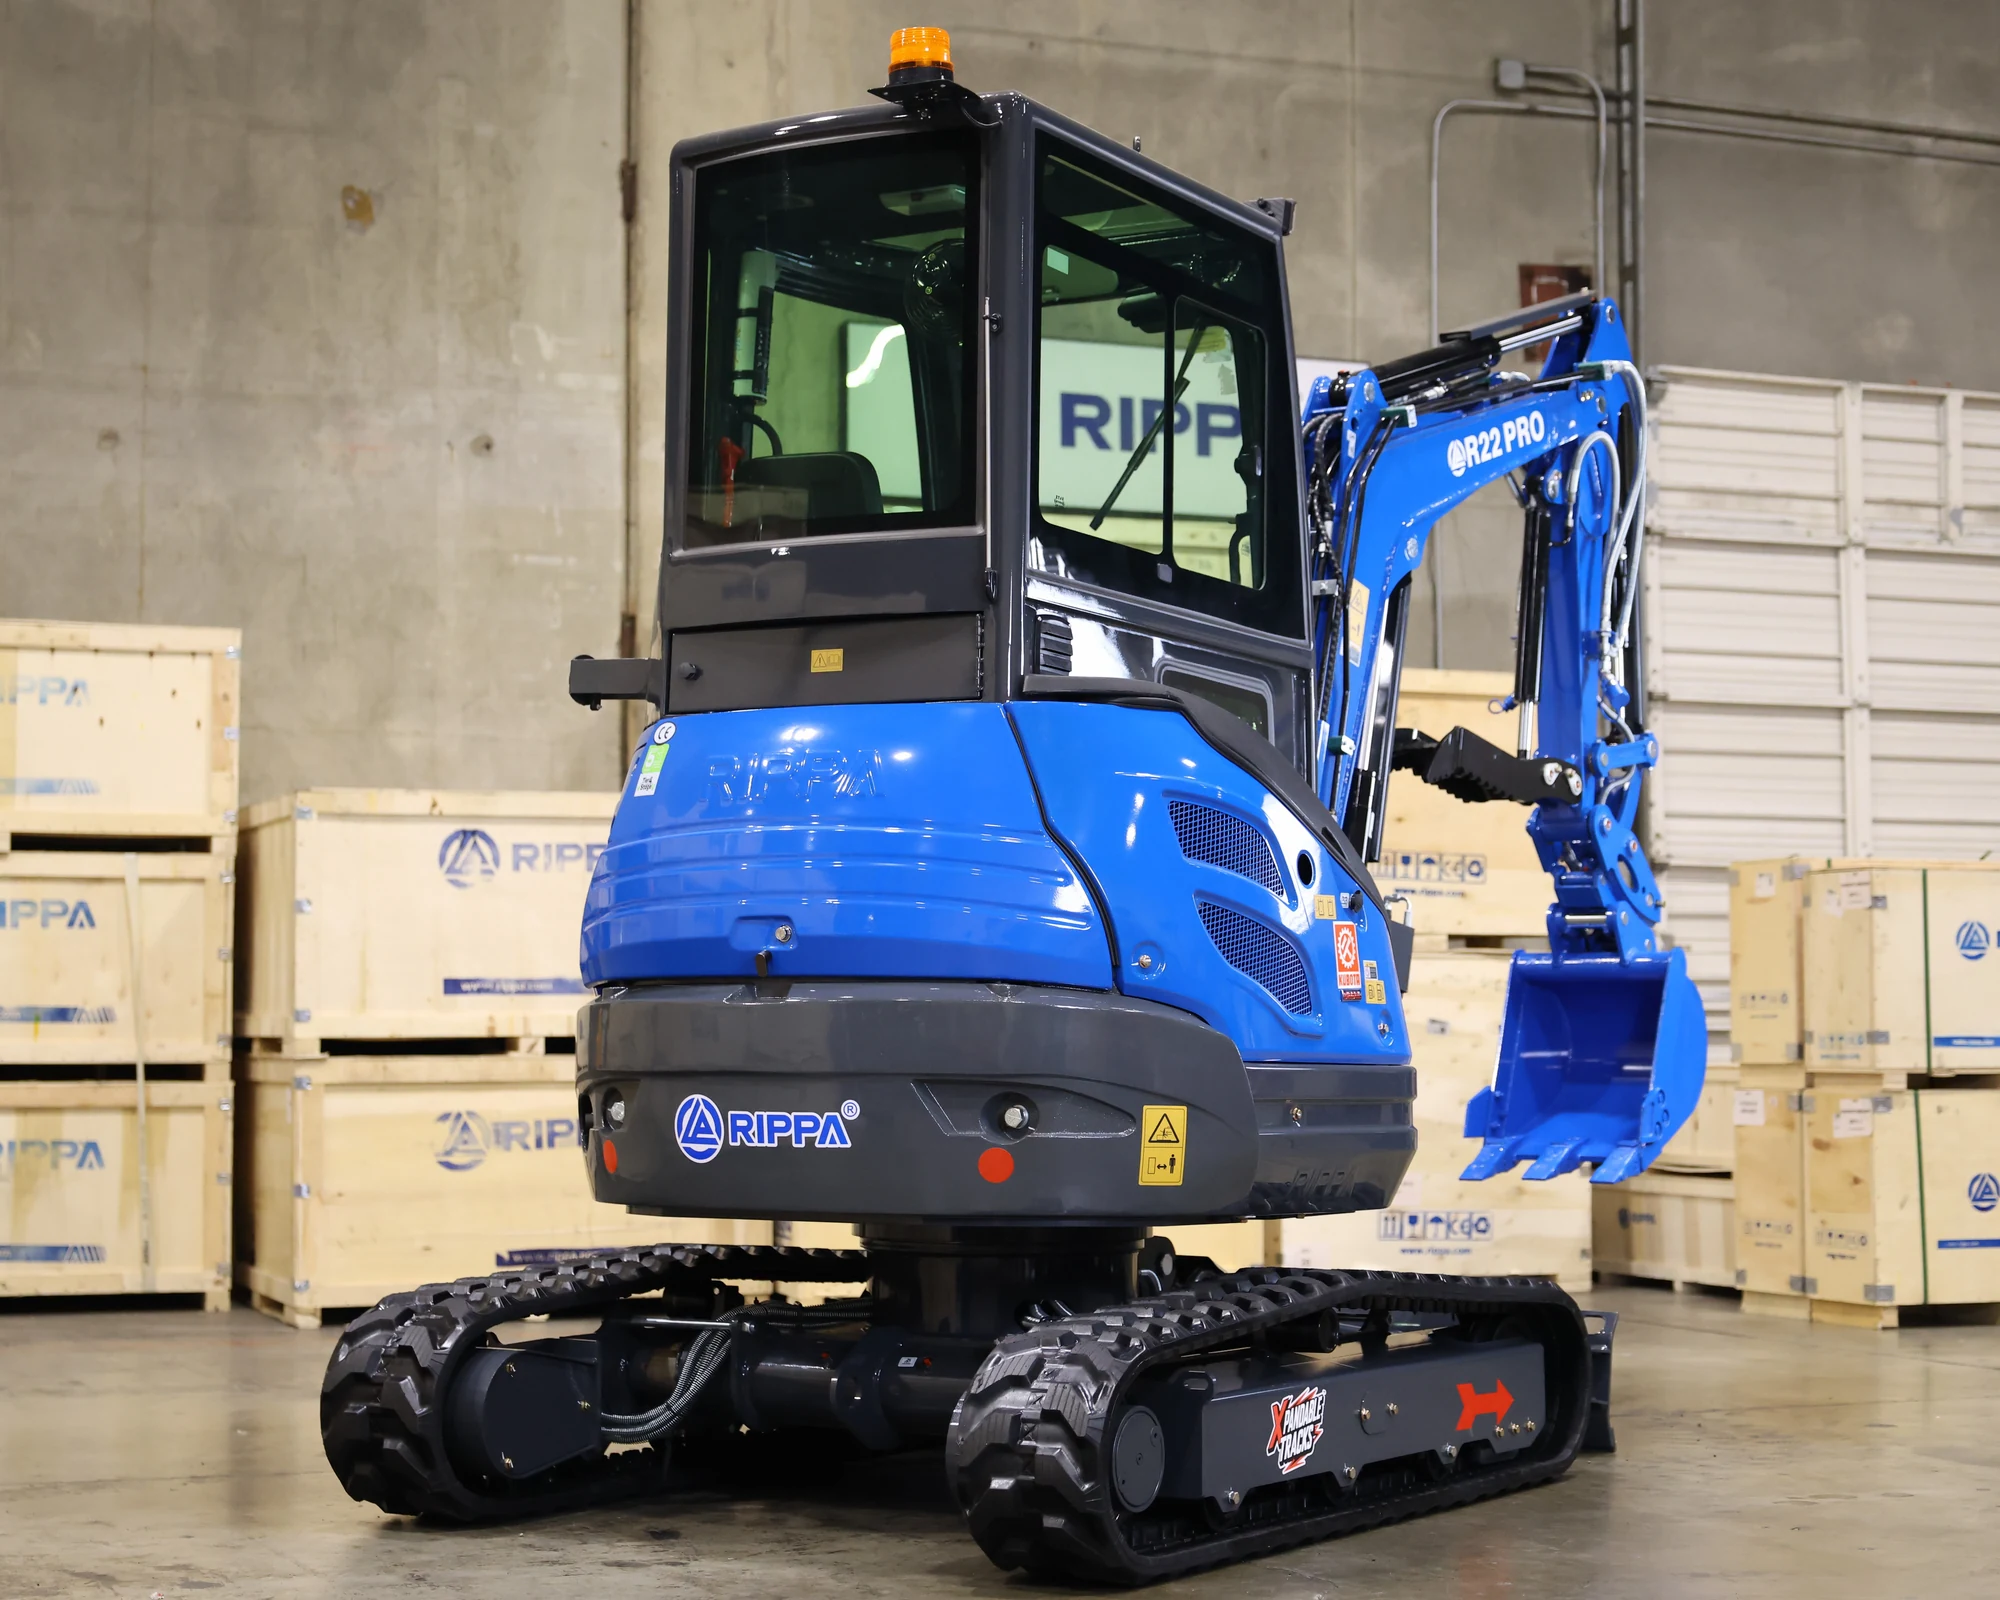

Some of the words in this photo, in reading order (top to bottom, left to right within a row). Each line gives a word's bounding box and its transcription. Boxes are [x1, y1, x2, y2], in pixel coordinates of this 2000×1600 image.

[1464, 426, 1503, 468] R22
[1503, 410, 1545, 453] PRO
[706, 750, 886, 802] RIPPA
[1338, 973, 1361, 987] KUBOTA
[1280, 1424, 1315, 1462] TRACKS
